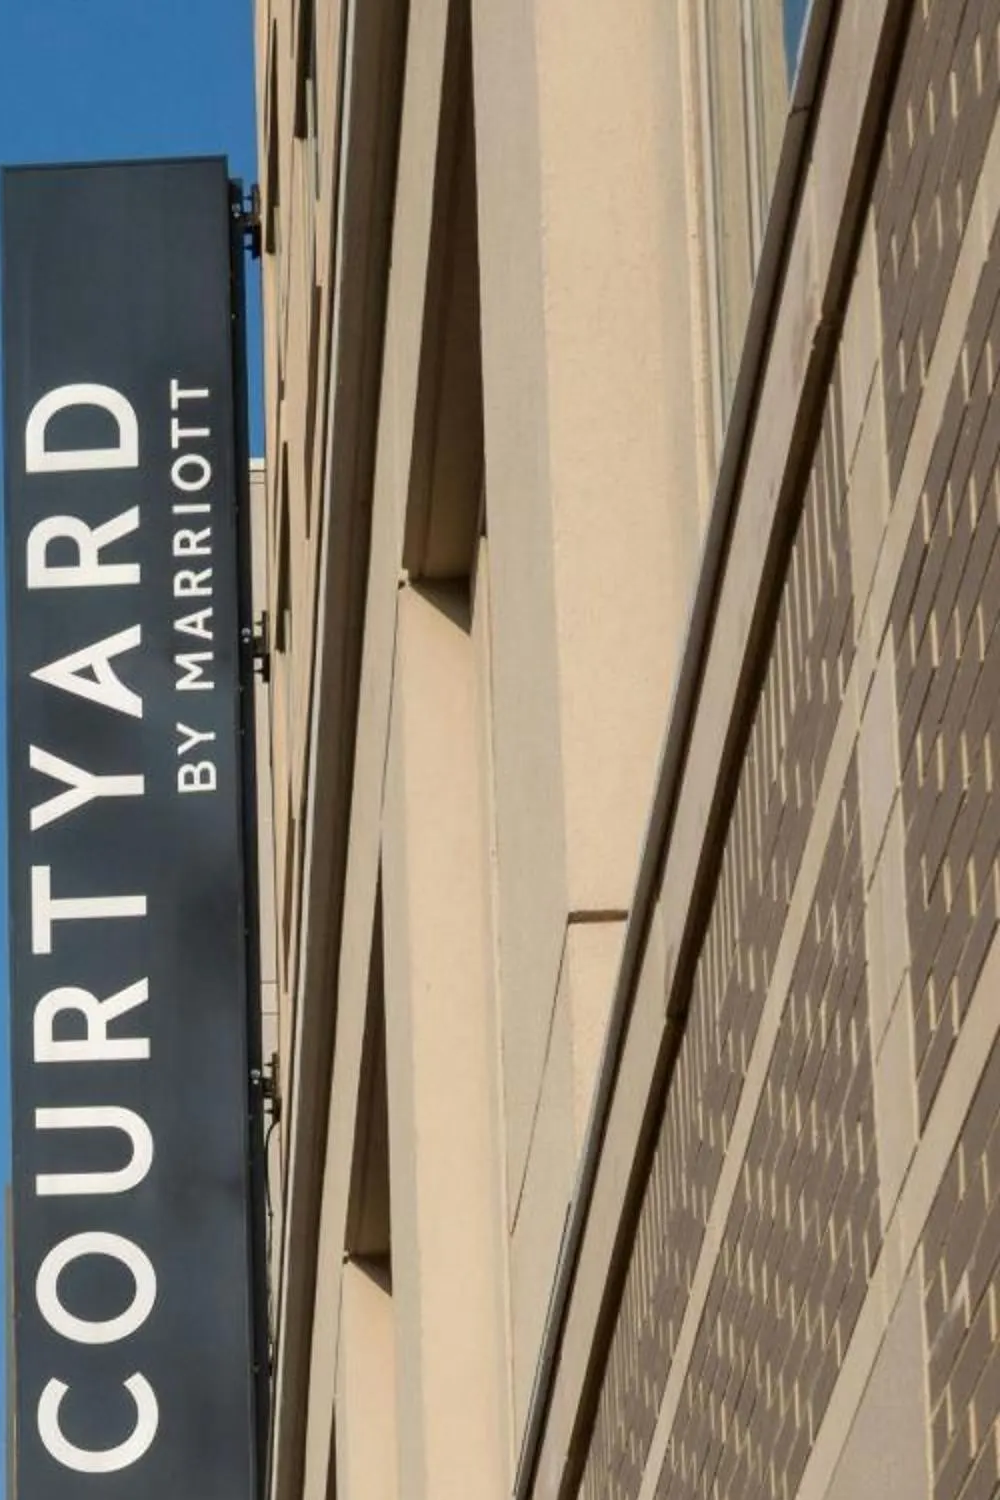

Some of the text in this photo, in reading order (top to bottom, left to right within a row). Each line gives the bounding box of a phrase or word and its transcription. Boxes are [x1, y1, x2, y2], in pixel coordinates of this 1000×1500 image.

[24, 382, 159, 1474] COURTYARD
[170, 378, 217, 793] BY MARRIOTT
